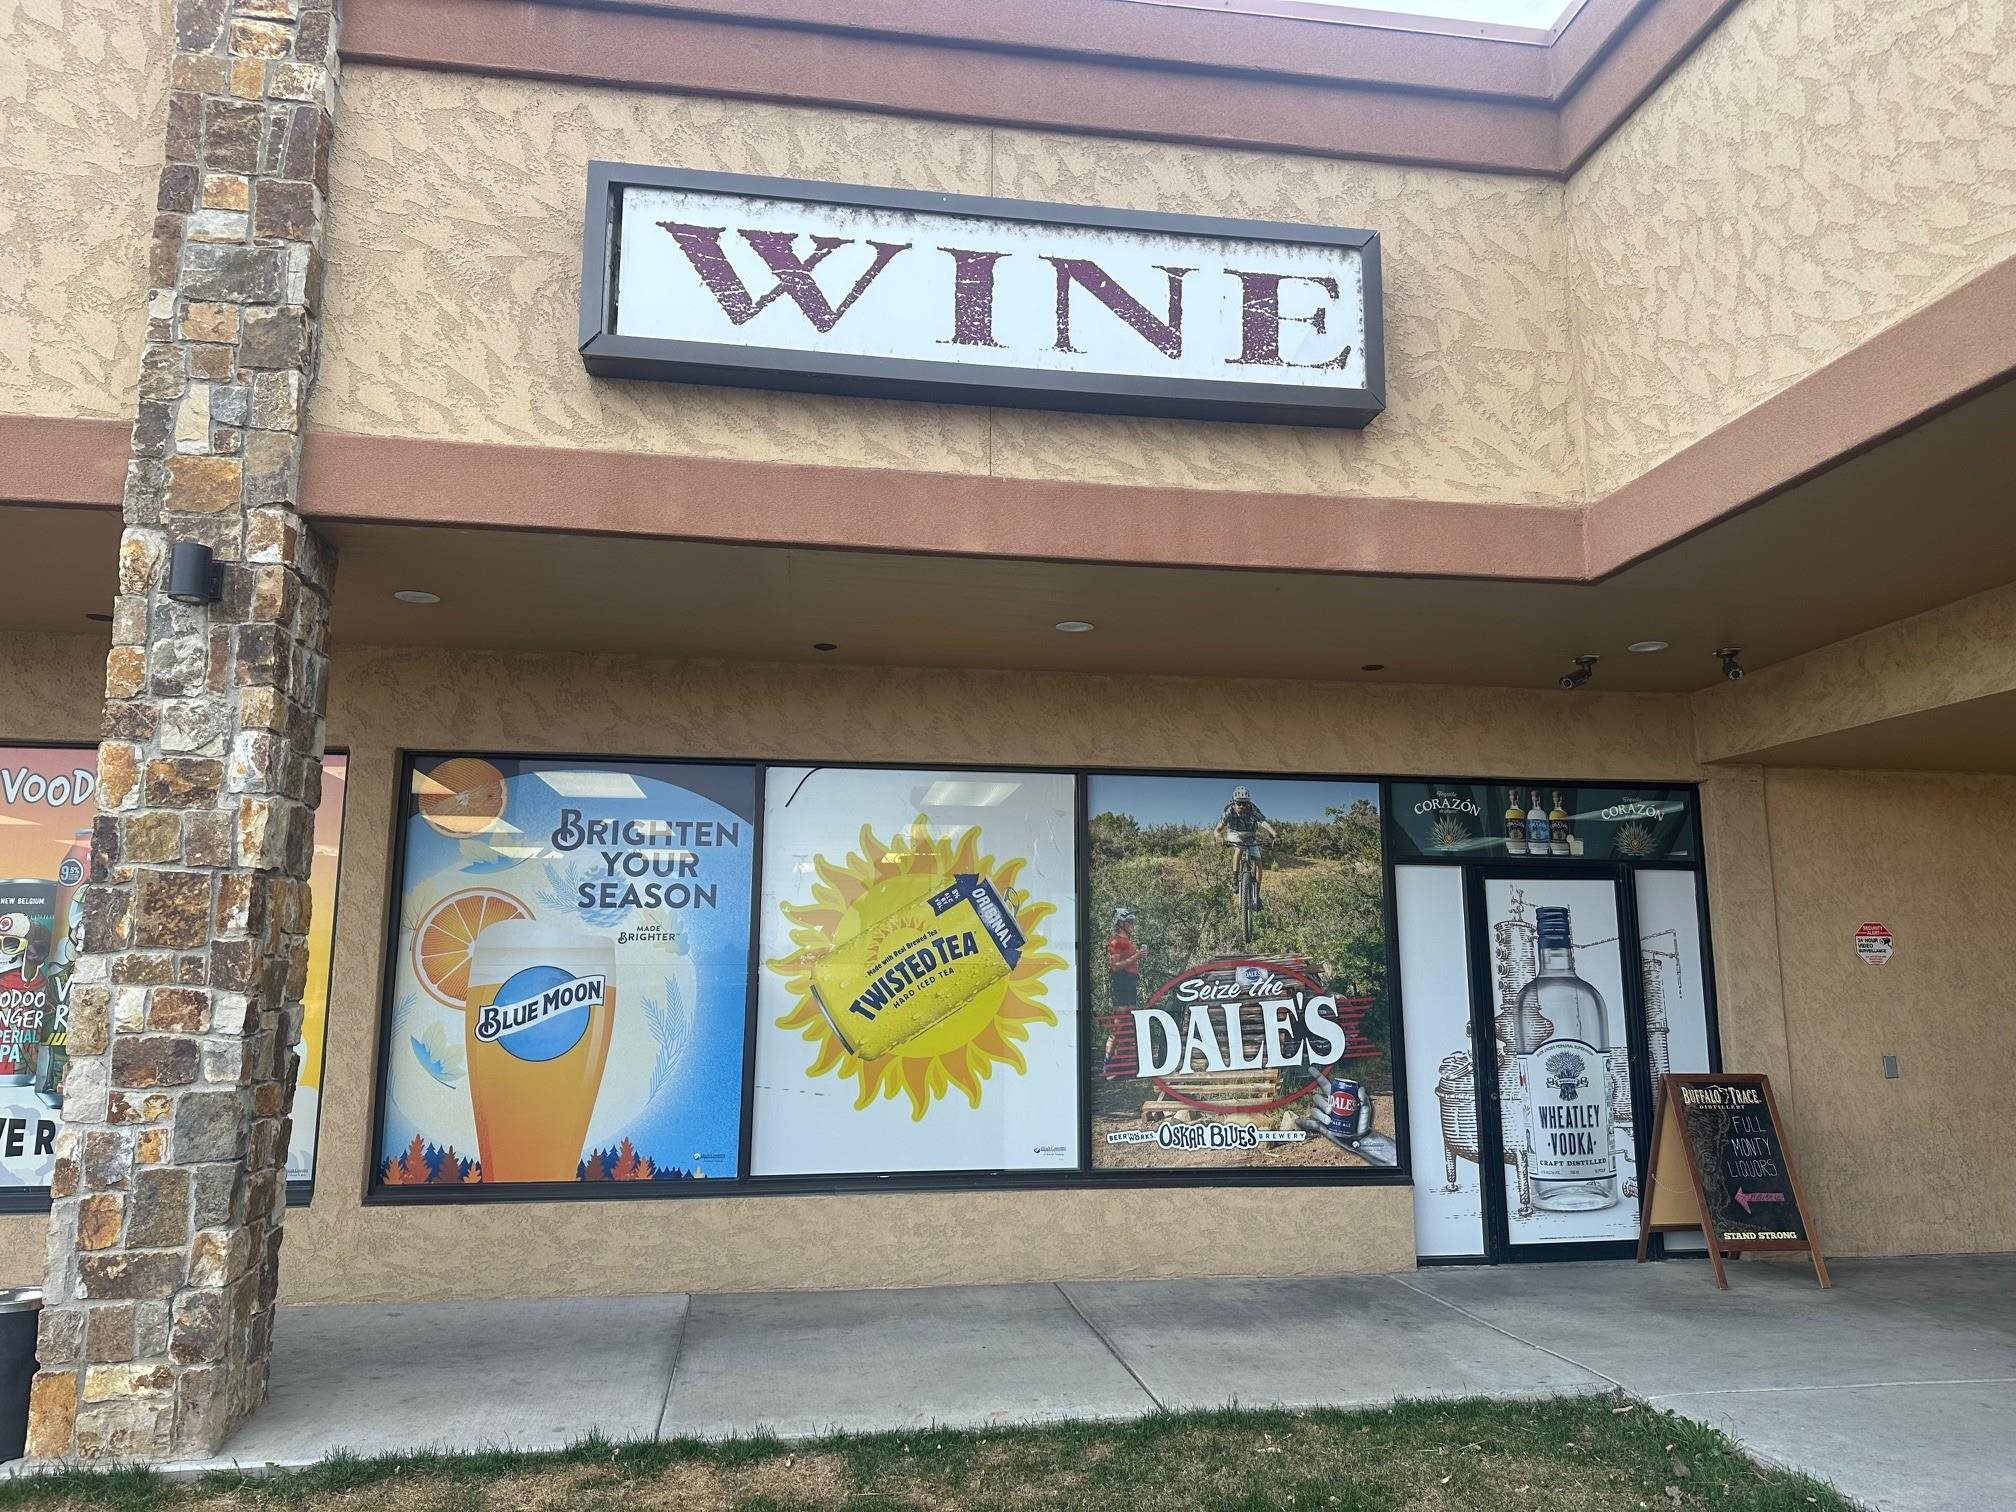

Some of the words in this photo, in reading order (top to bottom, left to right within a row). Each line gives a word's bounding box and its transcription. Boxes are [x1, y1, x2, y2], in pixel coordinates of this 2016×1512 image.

[656, 221, 1353, 369] WINE
[1414, 798, 1480, 816] CORAZÓN
[1601, 803, 1664, 821] CORAZÓN
[551, 808, 739, 851] BRIGHTEN
[600, 851, 700, 878] YOUR
[17, 897, 45, 905] BELGIUM
[577, 882, 718, 909] SEASON
[971, 887, 1014, 950] ORIGINAL
[893, 945, 907, 957] Real
[905, 933, 927, 949] Brewed
[849, 948, 937, 1021] TWISTED
[931, 931, 979, 965] TEA
[892, 988, 915, 1009] HARD
[917, 976, 936, 992] ICED
[938, 967, 955, 979] TEA
[1176, 978, 1241, 1002] Seize
[1247, 973, 1284, 998] the
[478, 1000, 540, 1039] BLUE
[542, 980, 602, 1016] MOON
[1131, 992, 1347, 1078] DALE'S
[1681, 1086, 1722, 1105] BUFFALO
[1727, 1086, 1760, 1104] TRACE
[1538, 1105, 1600, 1130] WHEATLEY
[1731, 1115, 1767, 1133] FULL
[1109, 1133, 1128, 1141] BEER
[1128, 1133, 1154, 1142] WORKS
[1159, 1123, 1207, 1149] OSKAR
[1210, 1124, 1257, 1147] BLUES
[1550, 1131, 1595, 1156] VODKA
[1730, 1137, 1772, 1157] MONTY
[1566, 1157, 1607, 1167] DISTILLED
[1726, 1158, 1778, 1178] LIQUORS
[1723, 1231, 1757, 1240] STAND
[1758, 1231, 1797, 1240] STRONG
